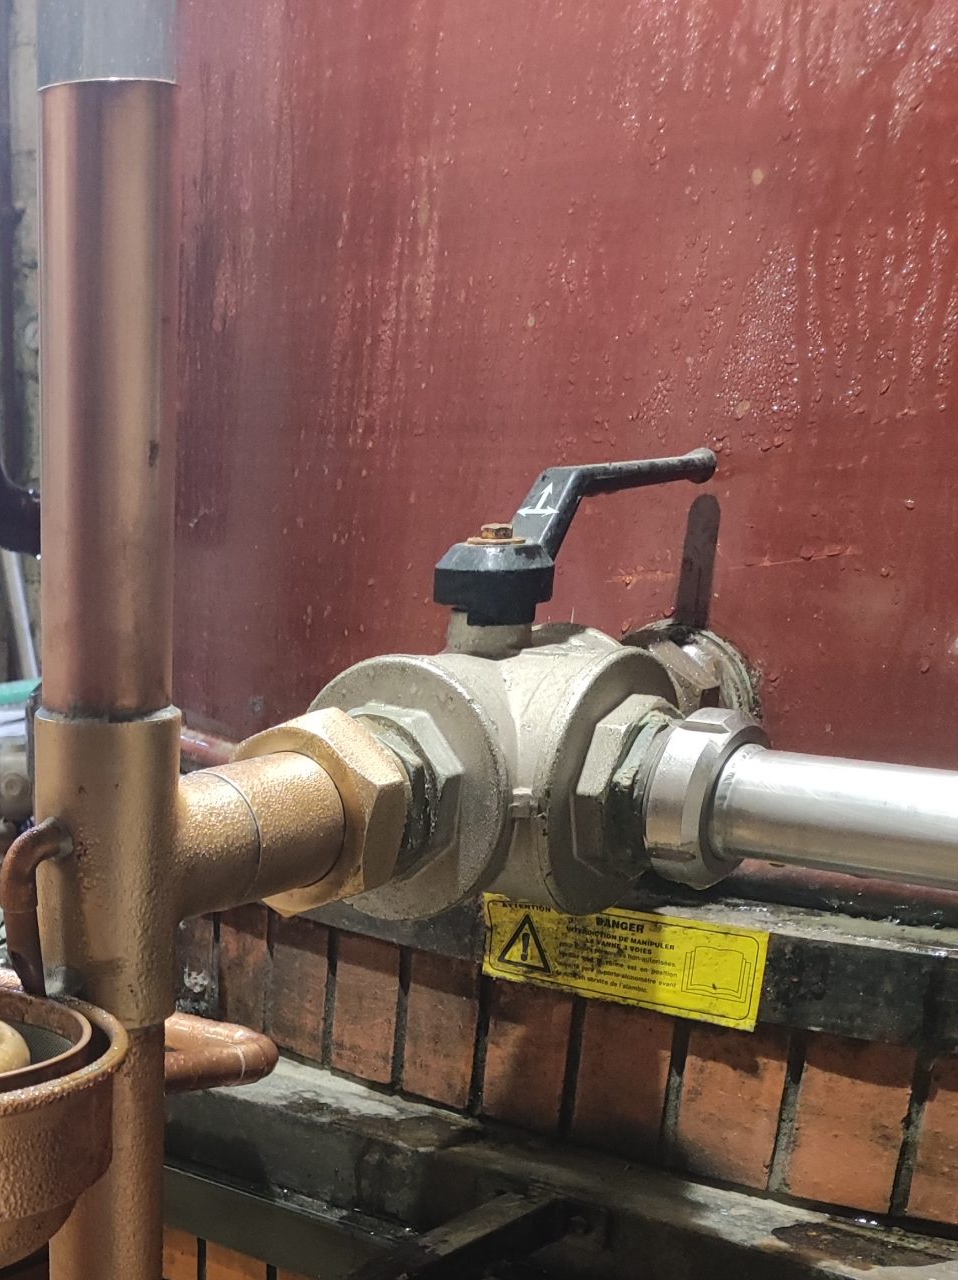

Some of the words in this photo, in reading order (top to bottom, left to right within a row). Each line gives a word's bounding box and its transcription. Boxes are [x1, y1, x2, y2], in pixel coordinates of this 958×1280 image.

[595, 916, 645, 933] DANGER
[618, 935, 629, 943] DE
[630, 937, 675, 950] MANIPULER
[629, 945, 653, 955] VOIES
